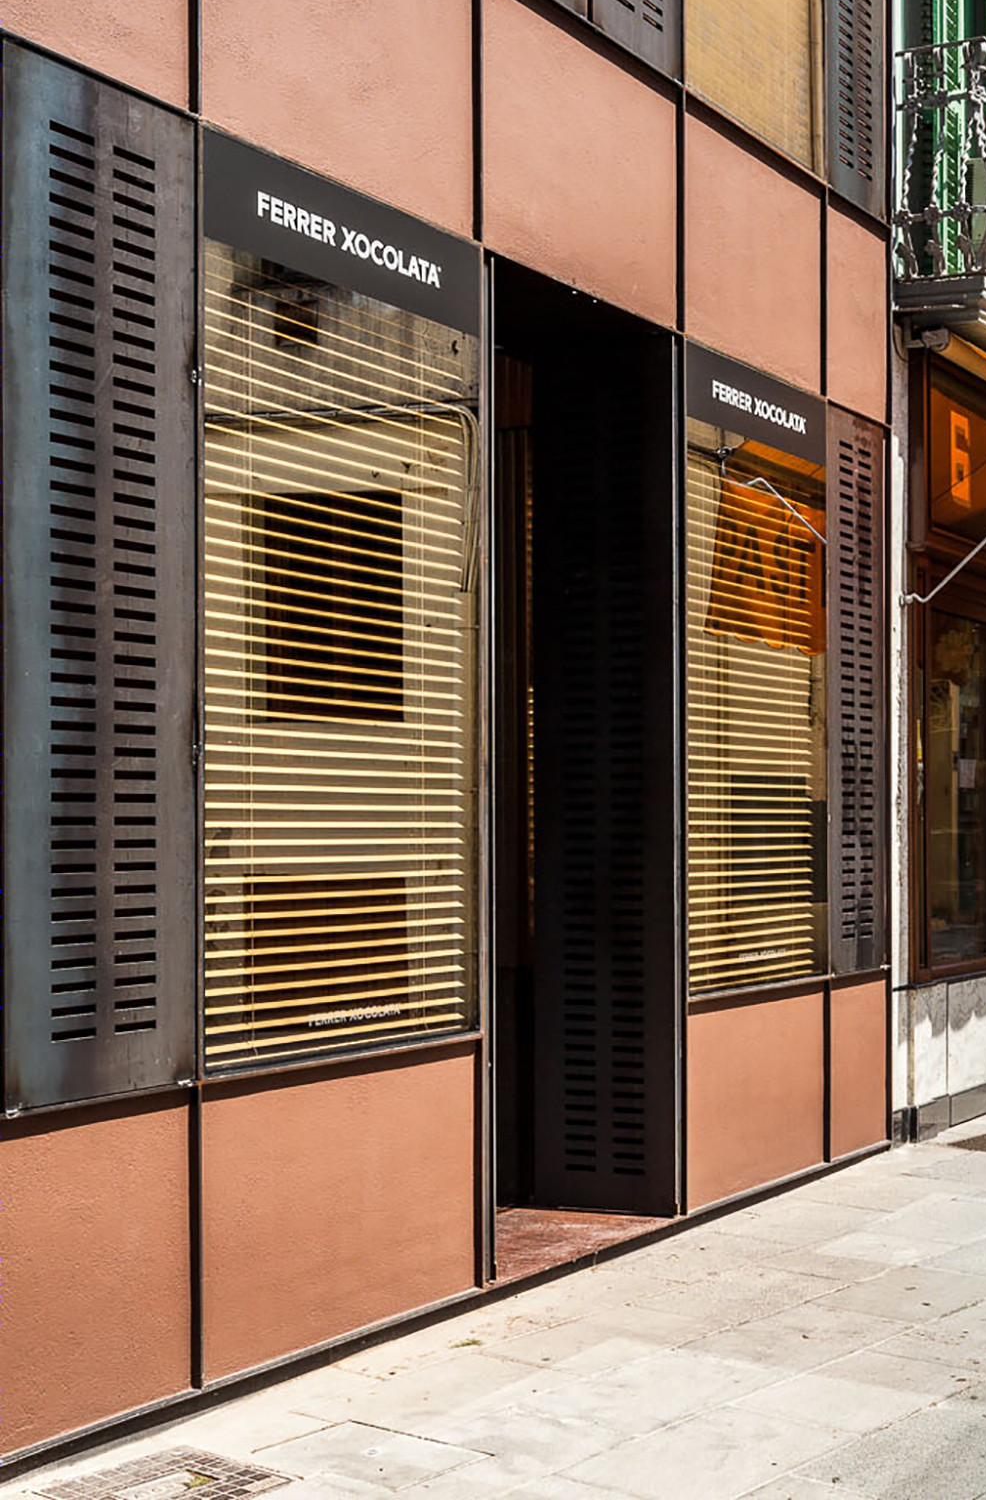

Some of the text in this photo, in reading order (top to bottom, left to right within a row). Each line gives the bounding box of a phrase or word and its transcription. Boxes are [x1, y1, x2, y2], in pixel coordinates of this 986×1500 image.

[257, 190, 441, 289] FERRER XOCOLATA
[712, 379, 806, 435] FERRER XOCOLATA
